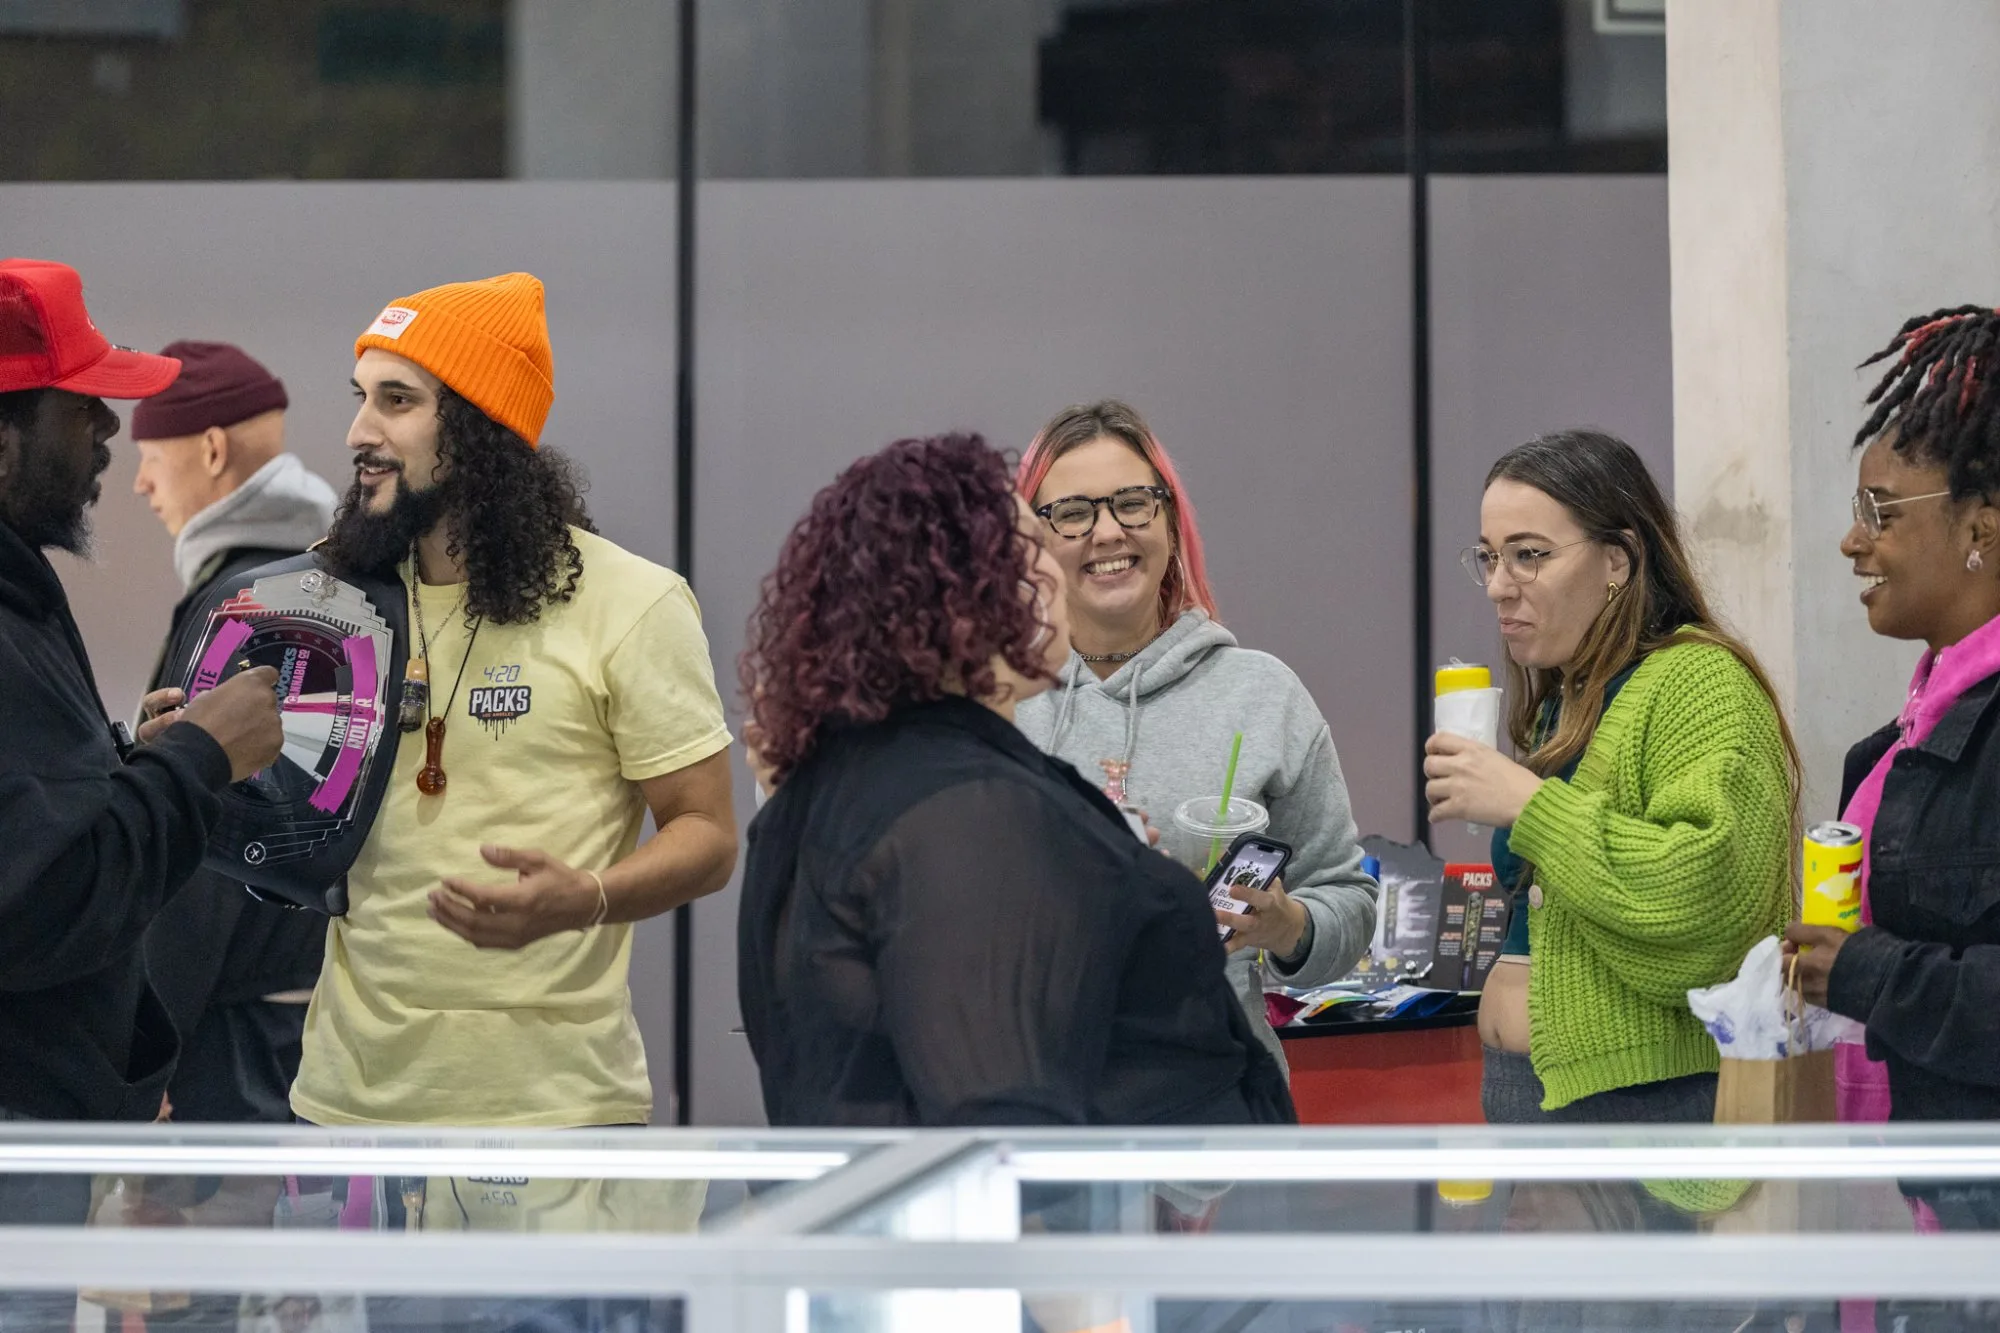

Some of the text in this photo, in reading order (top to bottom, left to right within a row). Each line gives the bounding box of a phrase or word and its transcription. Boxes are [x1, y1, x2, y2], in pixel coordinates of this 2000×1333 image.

[288, 660, 308, 705] CANNABIS
[471, 688, 529, 714] PACKS
[346, 697, 373, 750] ROLLR
[1462, 872, 1493, 887] PACKS
